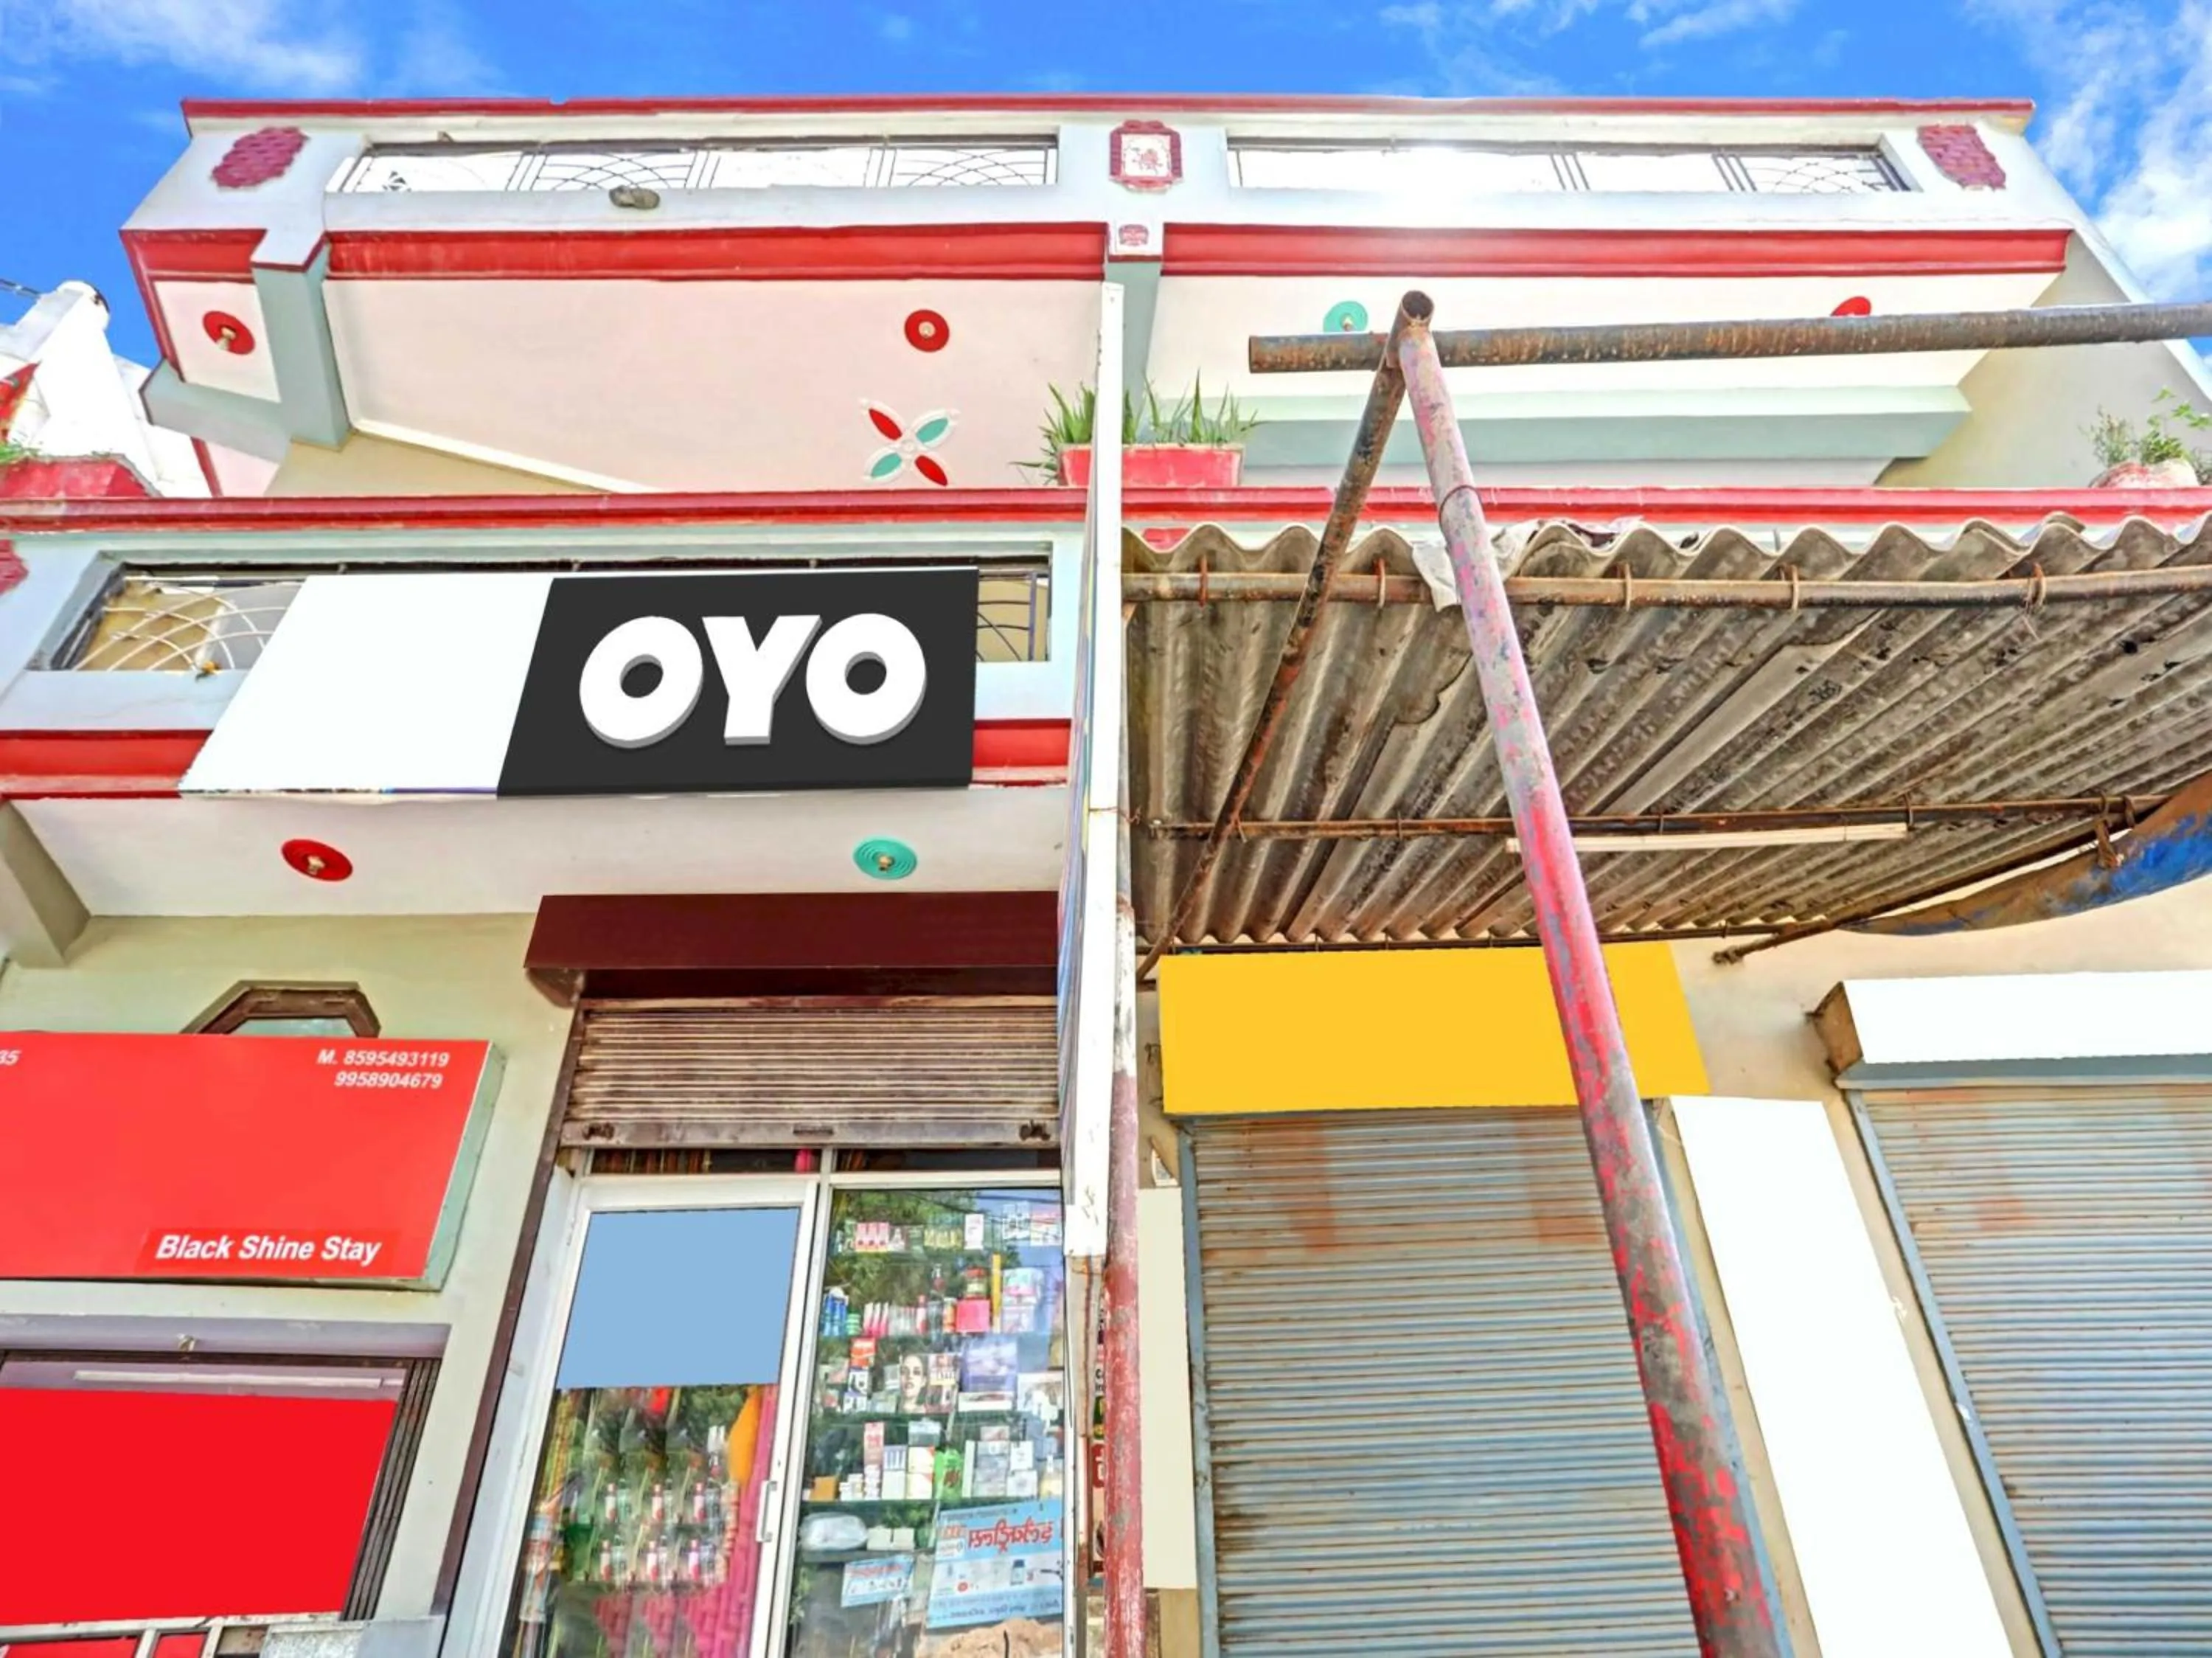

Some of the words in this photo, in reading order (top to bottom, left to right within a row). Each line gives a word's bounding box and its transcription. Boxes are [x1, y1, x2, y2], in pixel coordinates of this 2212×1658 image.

[580, 613, 927, 749] OYO
[316, 1048, 338, 1065] M.
[343, 1049, 451, 1067] 8595493119
[334, 1070, 444, 1089] 9958904679
[155, 1235, 234, 1259] Black
[238, 1235, 315, 1260] Shine
[321, 1235, 381, 1266] Stay
